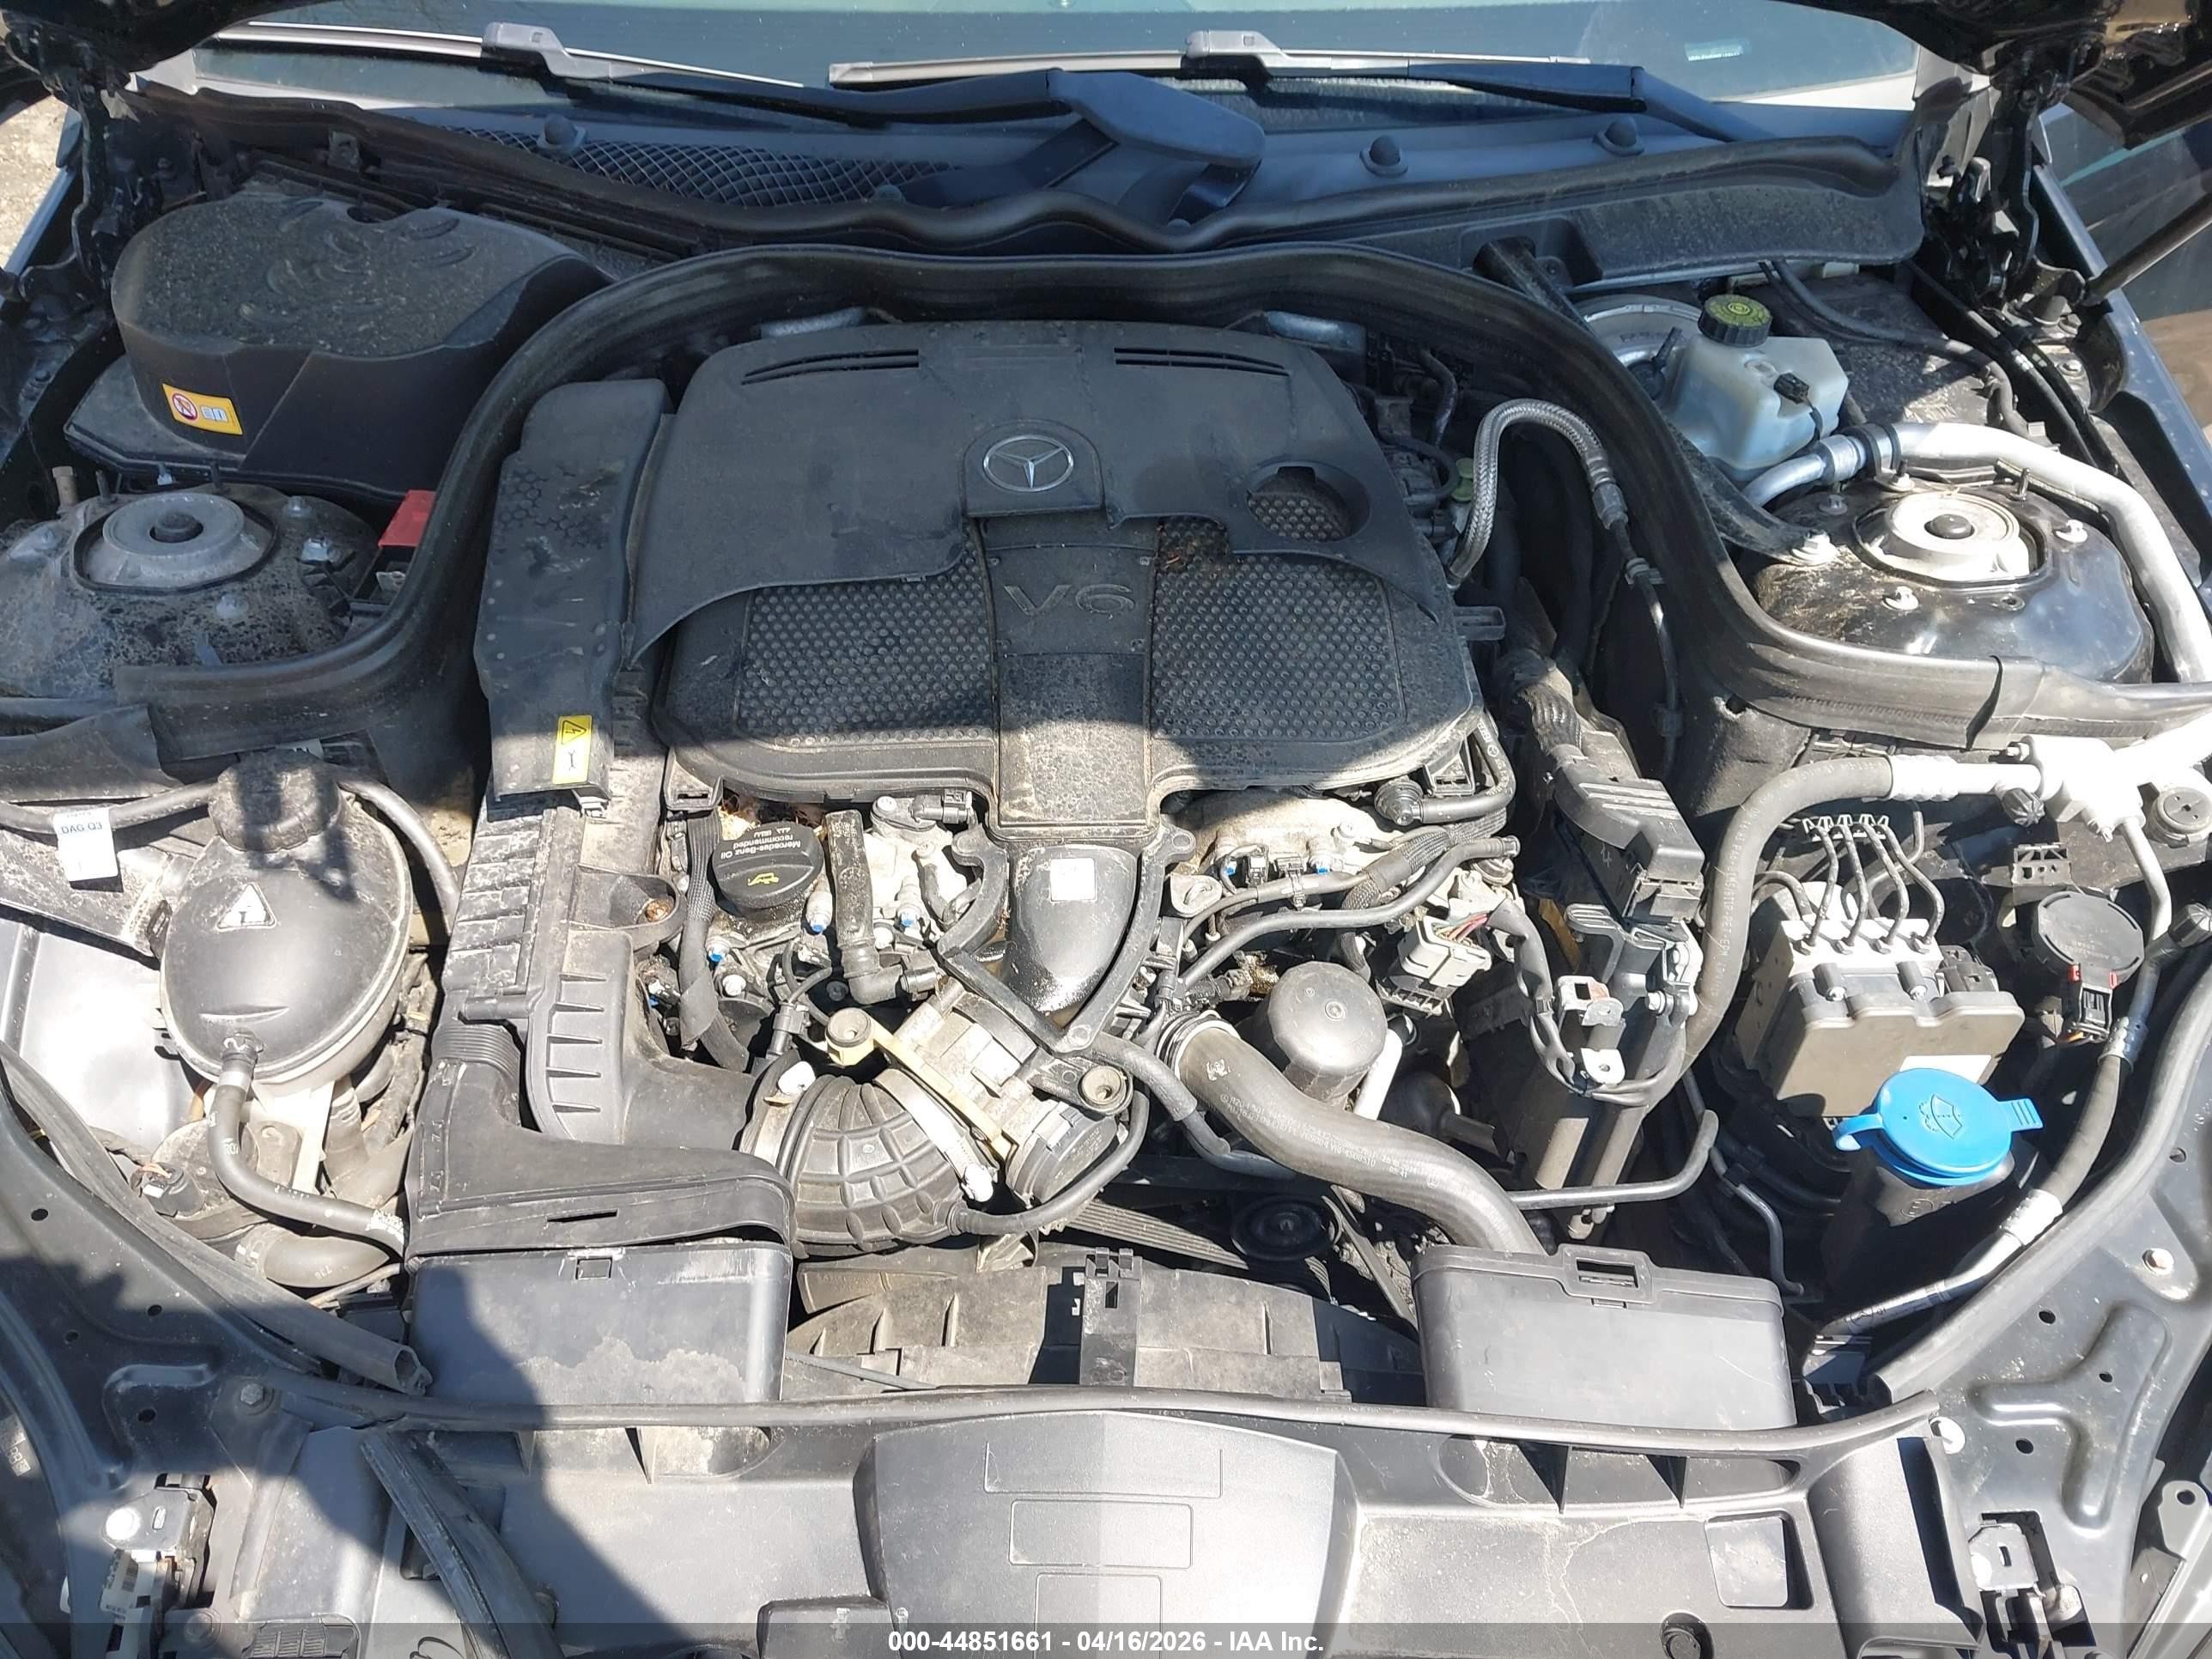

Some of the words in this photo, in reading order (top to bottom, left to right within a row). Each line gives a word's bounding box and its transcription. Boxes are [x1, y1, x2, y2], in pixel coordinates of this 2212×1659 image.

[1003, 583, 1134, 617] V6
[732, 834, 793, 850] recommended
[734, 840, 800, 856] Mercedes-Benz
[720, 851, 733, 860] Oil
